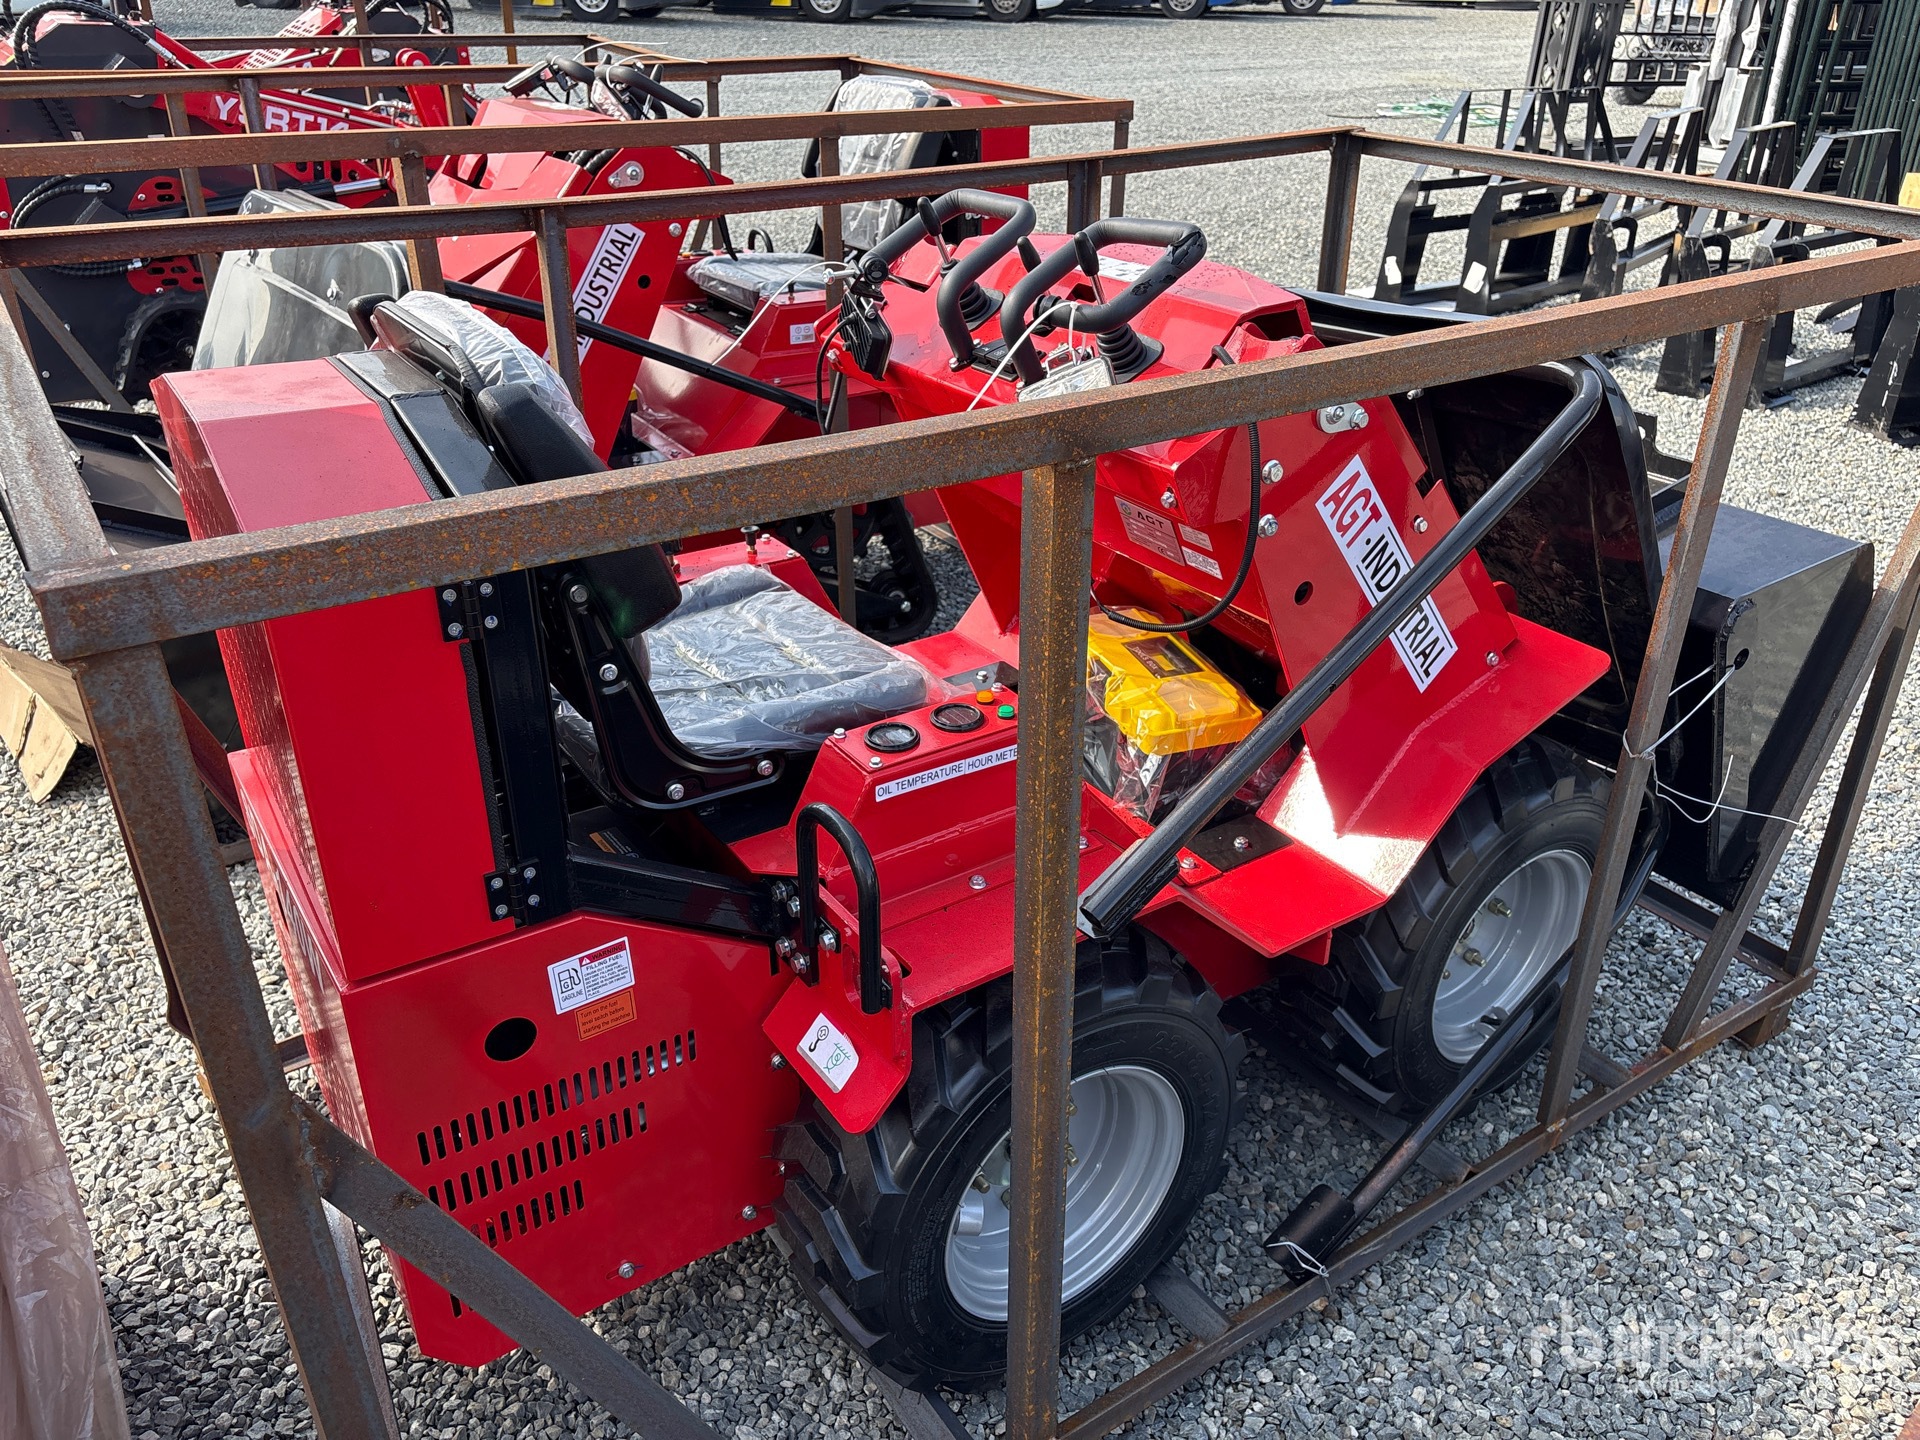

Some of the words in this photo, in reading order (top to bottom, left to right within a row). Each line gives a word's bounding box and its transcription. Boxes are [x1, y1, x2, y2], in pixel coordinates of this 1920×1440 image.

[1137, 511, 1164, 529] AGT
[967, 752, 994, 771] HOUR
[995, 747, 1018, 763] METE
[877, 785, 893, 798] OIL
[895, 762, 964, 792] TEMPERATURE
[592, 945, 623, 960] WARNING
[586, 960, 608, 971] FILLING
[609, 954, 623, 963] FUEL
[563, 981, 570, 990] G
[561, 988, 584, 1003] GASOLINE
[580, 1011, 593, 1019] Turn
[600, 1003, 608, 1011] the
[582, 1024, 602, 1035] starting
[610, 1011, 631, 1024] machine
